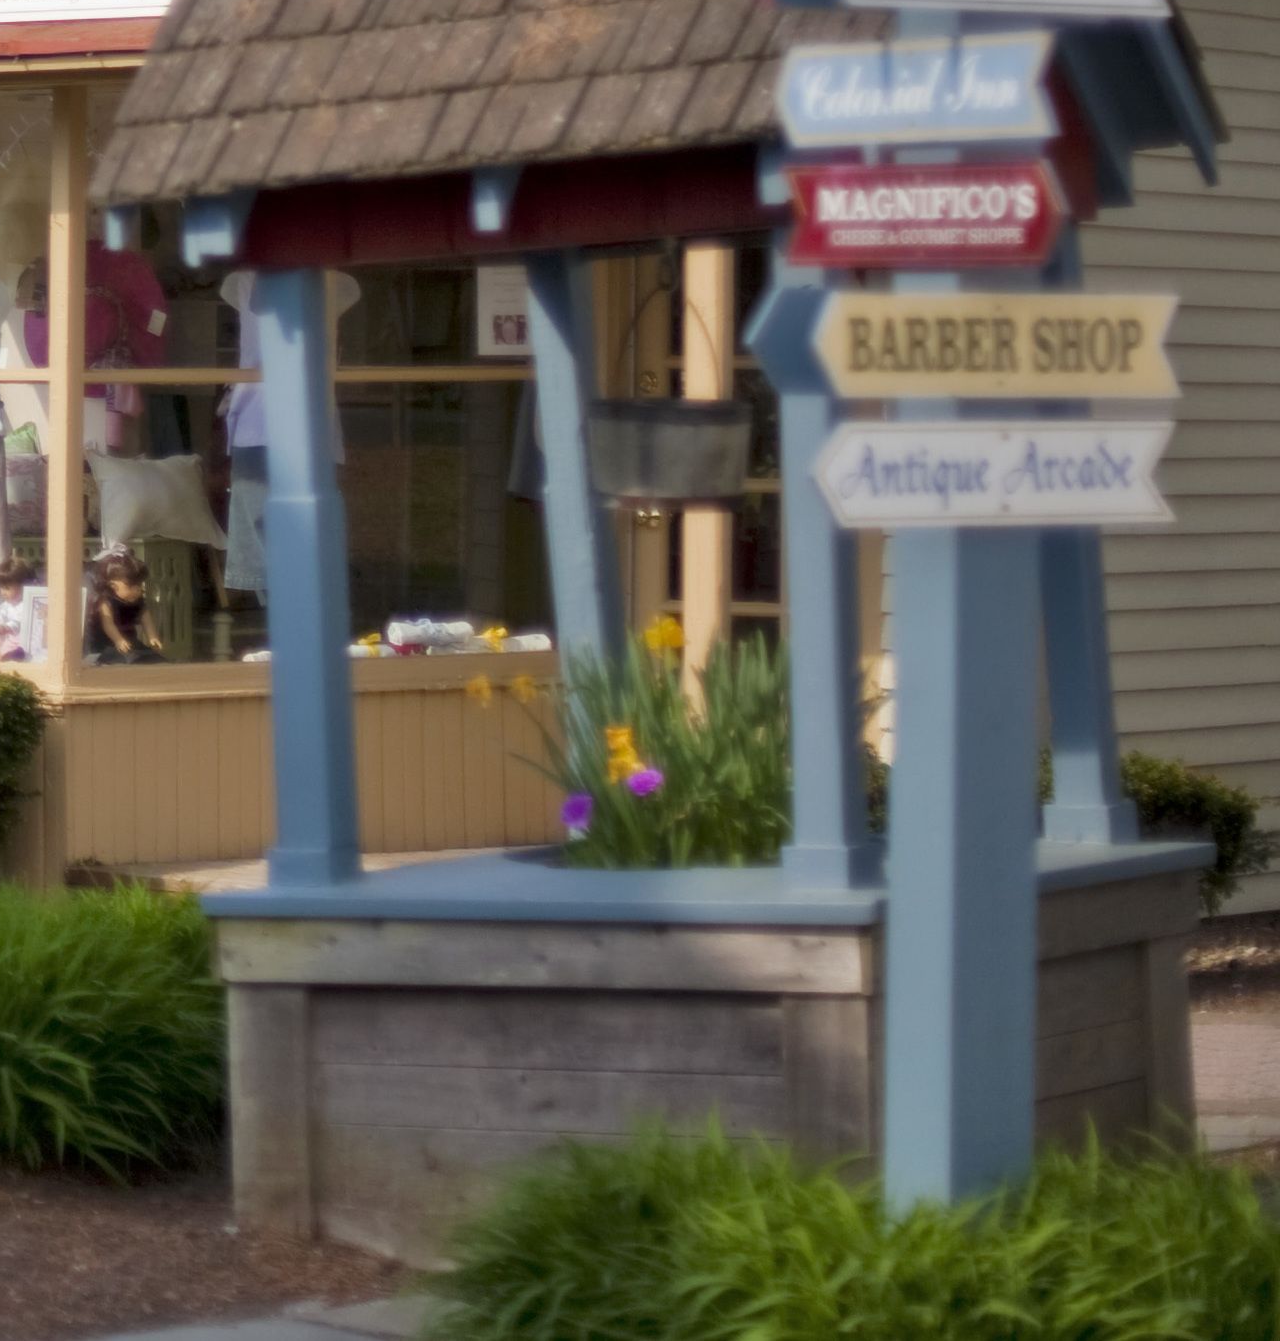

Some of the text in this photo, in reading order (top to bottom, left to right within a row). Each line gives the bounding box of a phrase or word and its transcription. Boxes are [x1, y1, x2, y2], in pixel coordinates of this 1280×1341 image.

[945, 54, 1019, 111] Inn
[817, 185, 1037, 221] MAGNIFICO'S
[831, 229, 885, 246] CHEESE
[900, 228, 962, 245] GOURMET
[968, 227, 1025, 244] SHOPPE
[848, 317, 1143, 373] BARBER SHOP
[841, 439, 1134, 511] Antique Arcade
